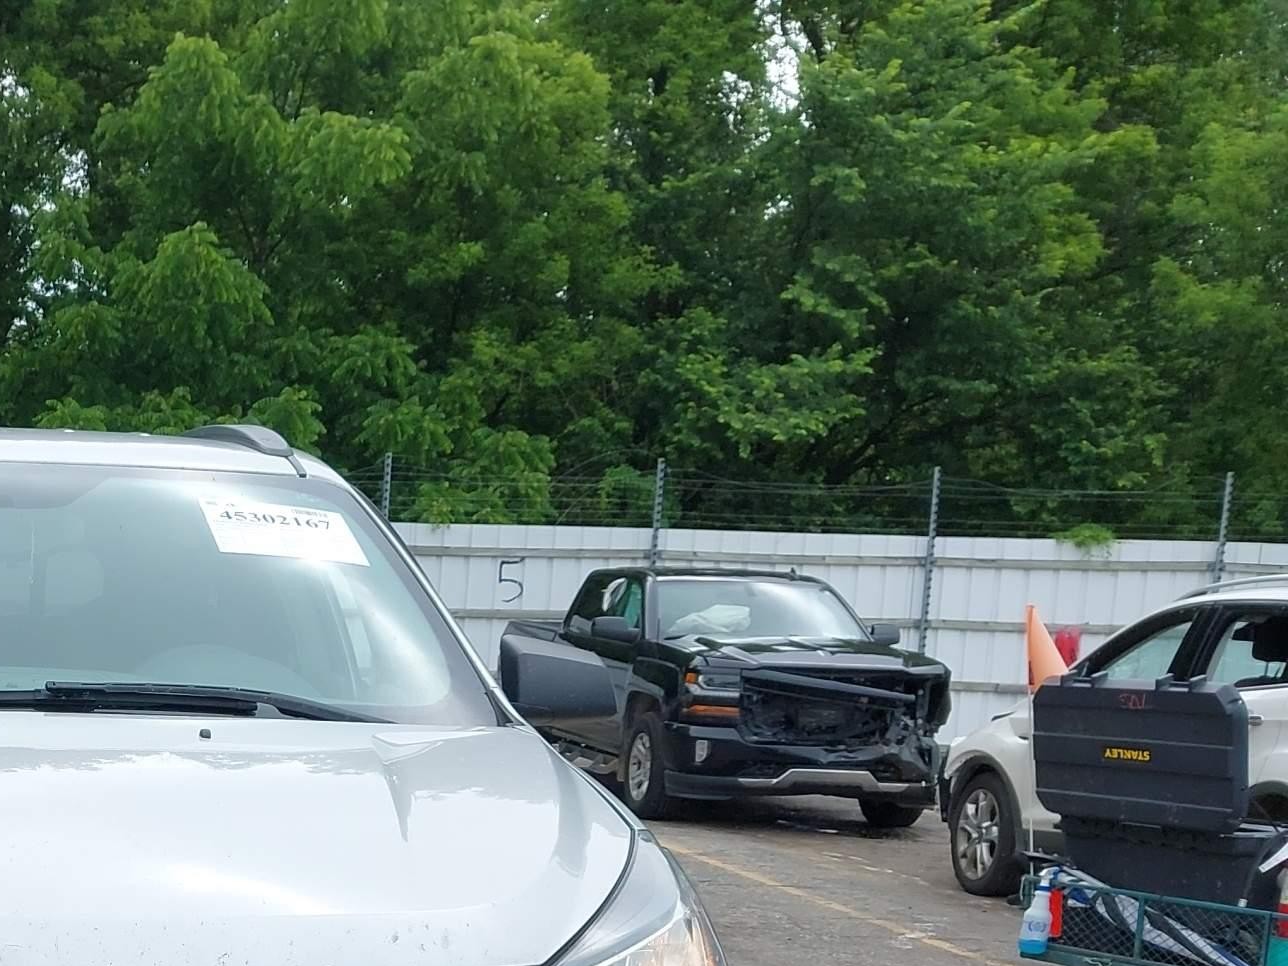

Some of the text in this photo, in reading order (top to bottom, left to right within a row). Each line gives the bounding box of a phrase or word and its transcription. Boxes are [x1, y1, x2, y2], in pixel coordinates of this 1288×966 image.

[219, 510, 330, 530] 45302167
[498, 557, 525, 603] 5
[1104, 748, 1151, 761] STANLEY
